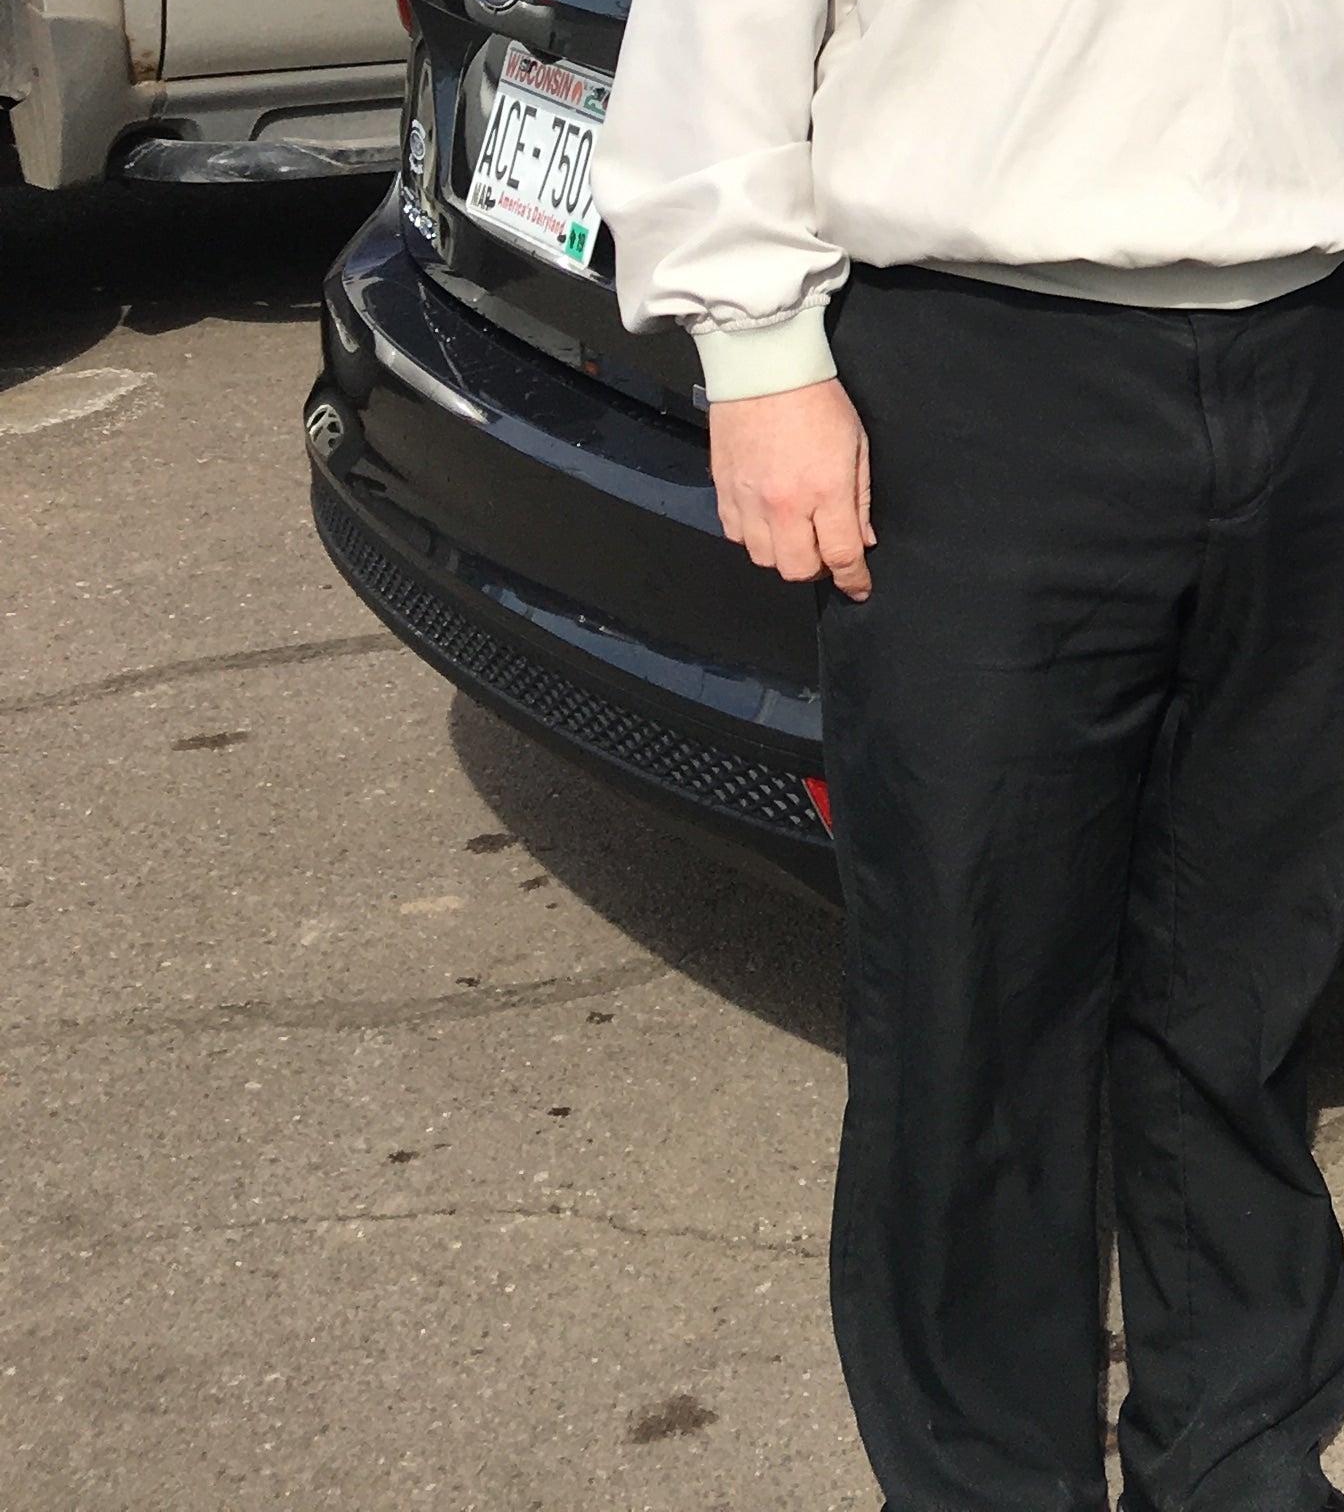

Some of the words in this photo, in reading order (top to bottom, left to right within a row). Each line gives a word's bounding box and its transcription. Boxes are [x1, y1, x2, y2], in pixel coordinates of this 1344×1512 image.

[504, 50, 575, 100] WISCONSIN
[478, 95, 594, 219] ACE-750
[498, 190, 532, 221] America's
